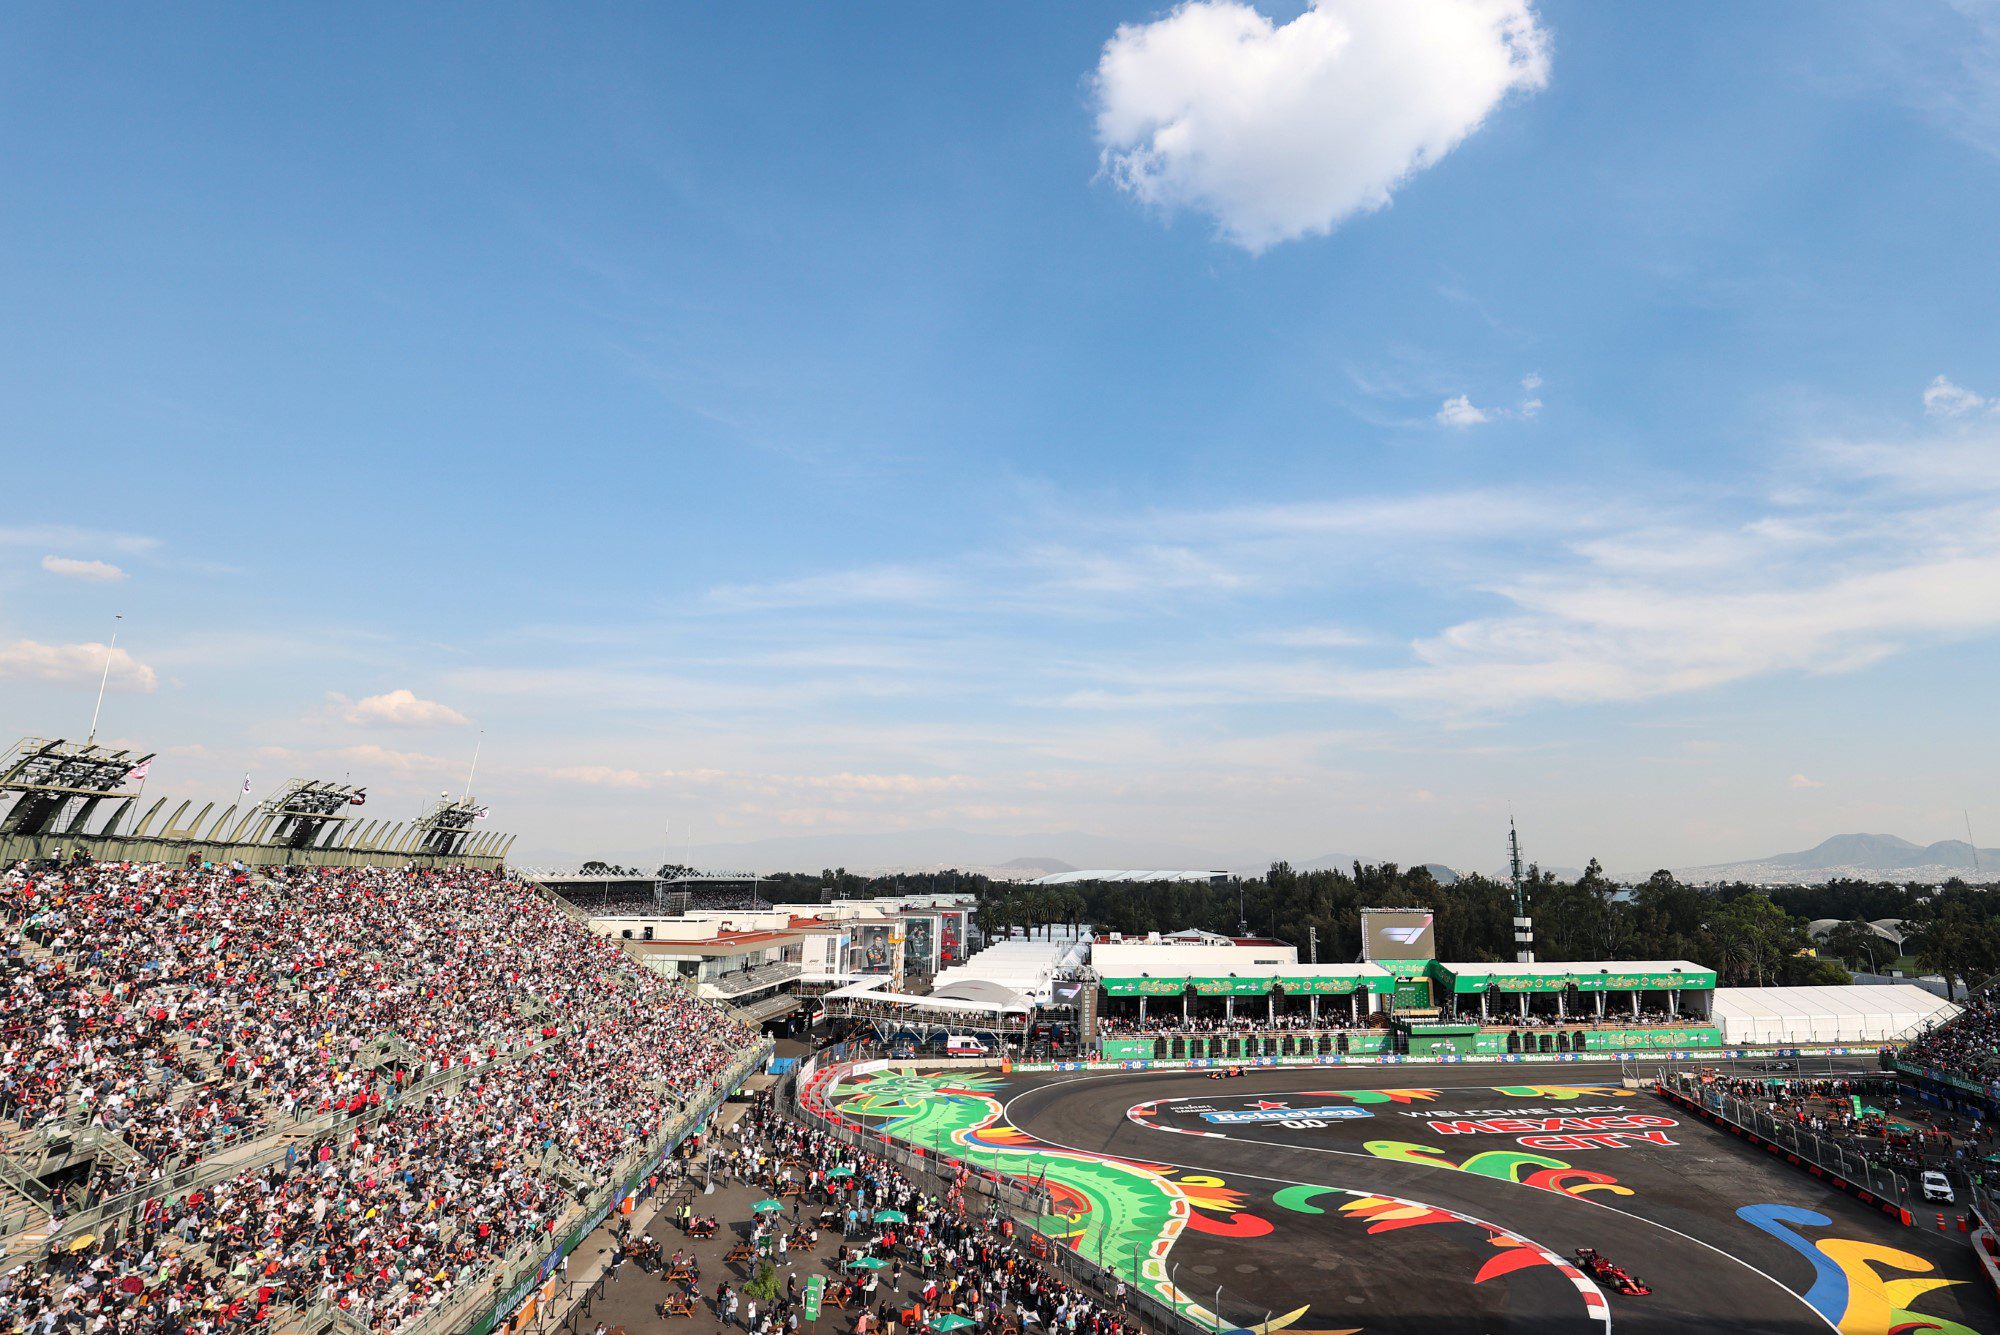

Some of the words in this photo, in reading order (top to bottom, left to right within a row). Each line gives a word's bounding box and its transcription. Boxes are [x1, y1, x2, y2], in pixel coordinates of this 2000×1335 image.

[1345, 1055, 1375, 1063] Heineken
[1407, 1055, 1435, 1063] Heineken
[1466, 1054, 1496, 1062] Heineken
[1583, 1053, 1610, 1061] Heineken
[1639, 1052, 1666, 1060] Heineken
[1693, 1051, 1720, 1059] Heineken
[1153, 1060, 1185, 1068] Heineken
[1218, 1058, 1250, 1066] Heineken
[1282, 1056, 1313, 1064] Heineken
[1018, 1064, 1051, 1072] Heineken
[1087, 1061, 1119, 1070] Heineken
[1212, 1109, 1363, 1122] Heineken
[1398, 1107, 1555, 1118] WELCOME
[1551, 1106, 1638, 1114] BACK
[1516, 1131, 1680, 1150] CITY
[493, 1275, 536, 1328] Heineken
